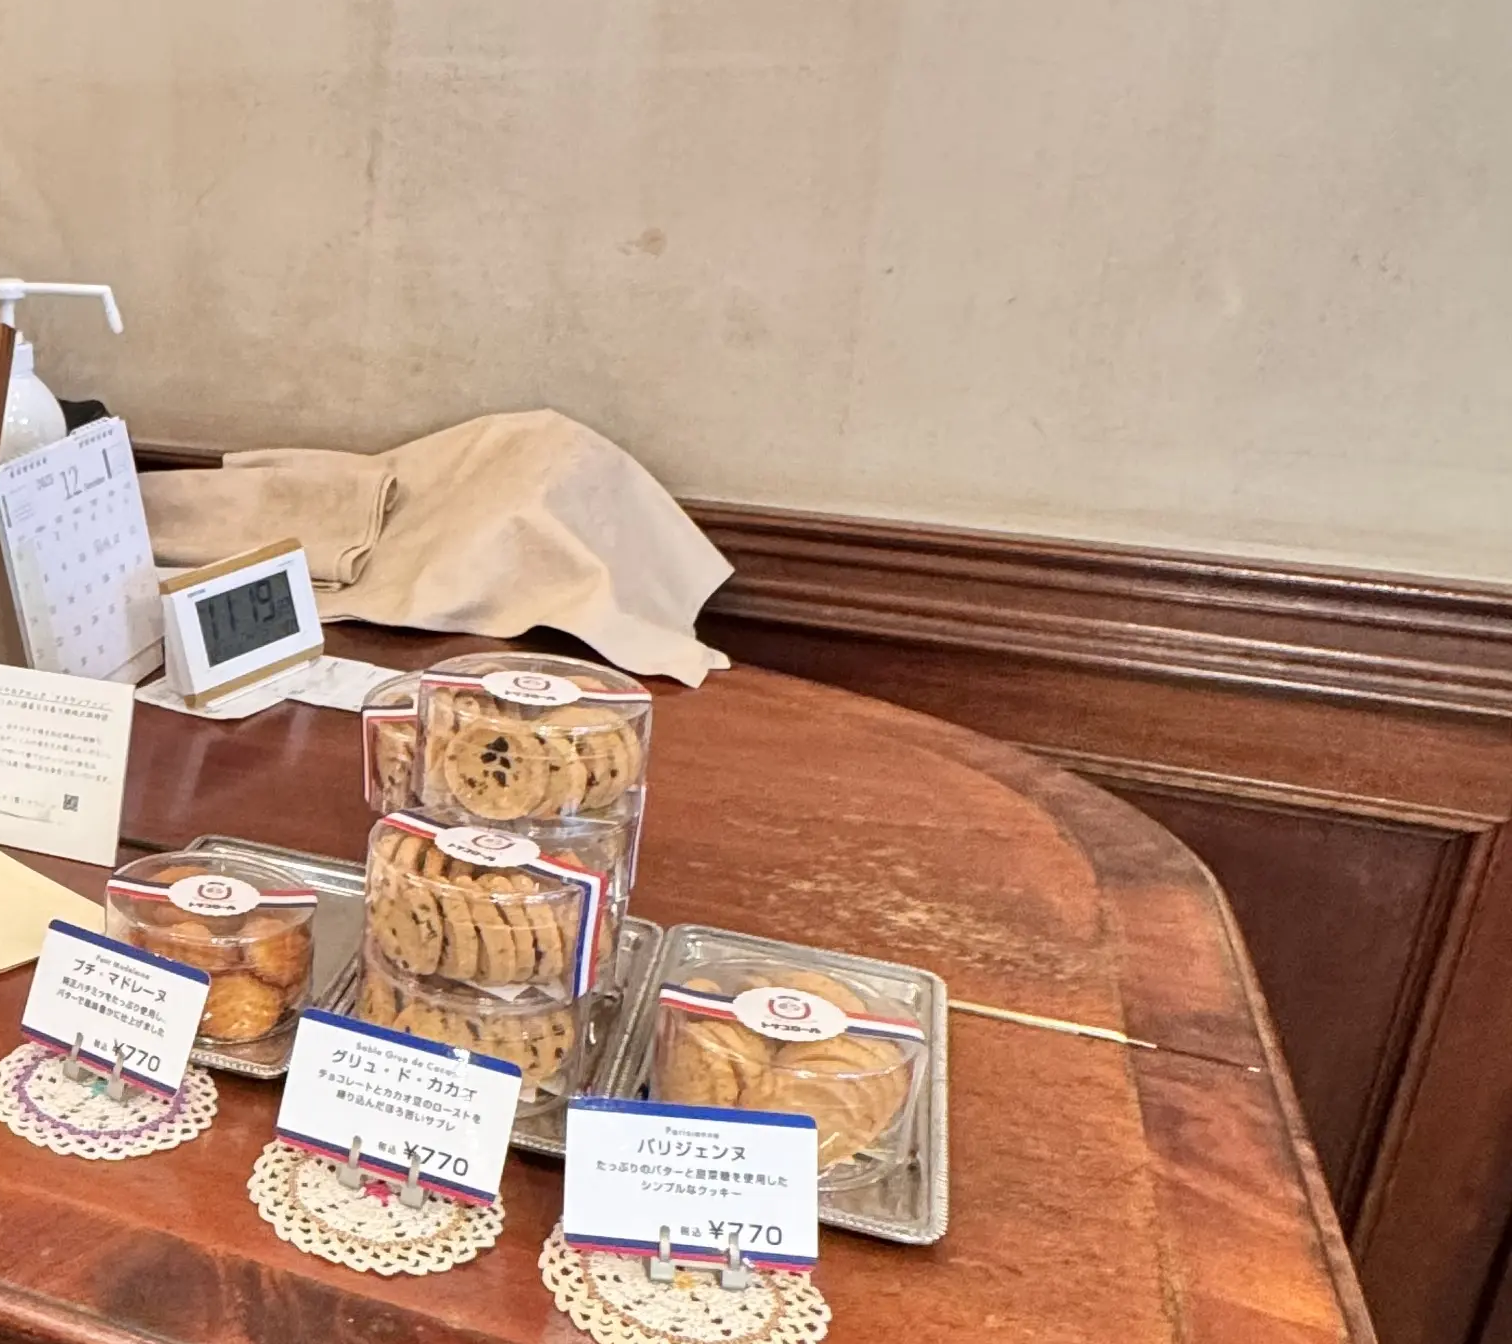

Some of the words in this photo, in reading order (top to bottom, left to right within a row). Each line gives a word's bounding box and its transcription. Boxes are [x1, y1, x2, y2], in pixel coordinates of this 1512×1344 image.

[59, 465, 83, 501] 12
[72, 958, 167, 1003] プチ・マドレーヌ
[112, 1038, 161, 1073] ¥770
[318, 1068, 481, 1125] チョコレートとカカオ豆のローストを
[403, 1141, 469, 1177] ¥770
[596, 1159, 788, 1187] たっぷりのバターと甜菜糖を使用した
[641, 1180, 742, 1197] シンプルなクッキー
[708, 1220, 783, 1246] ¥770
